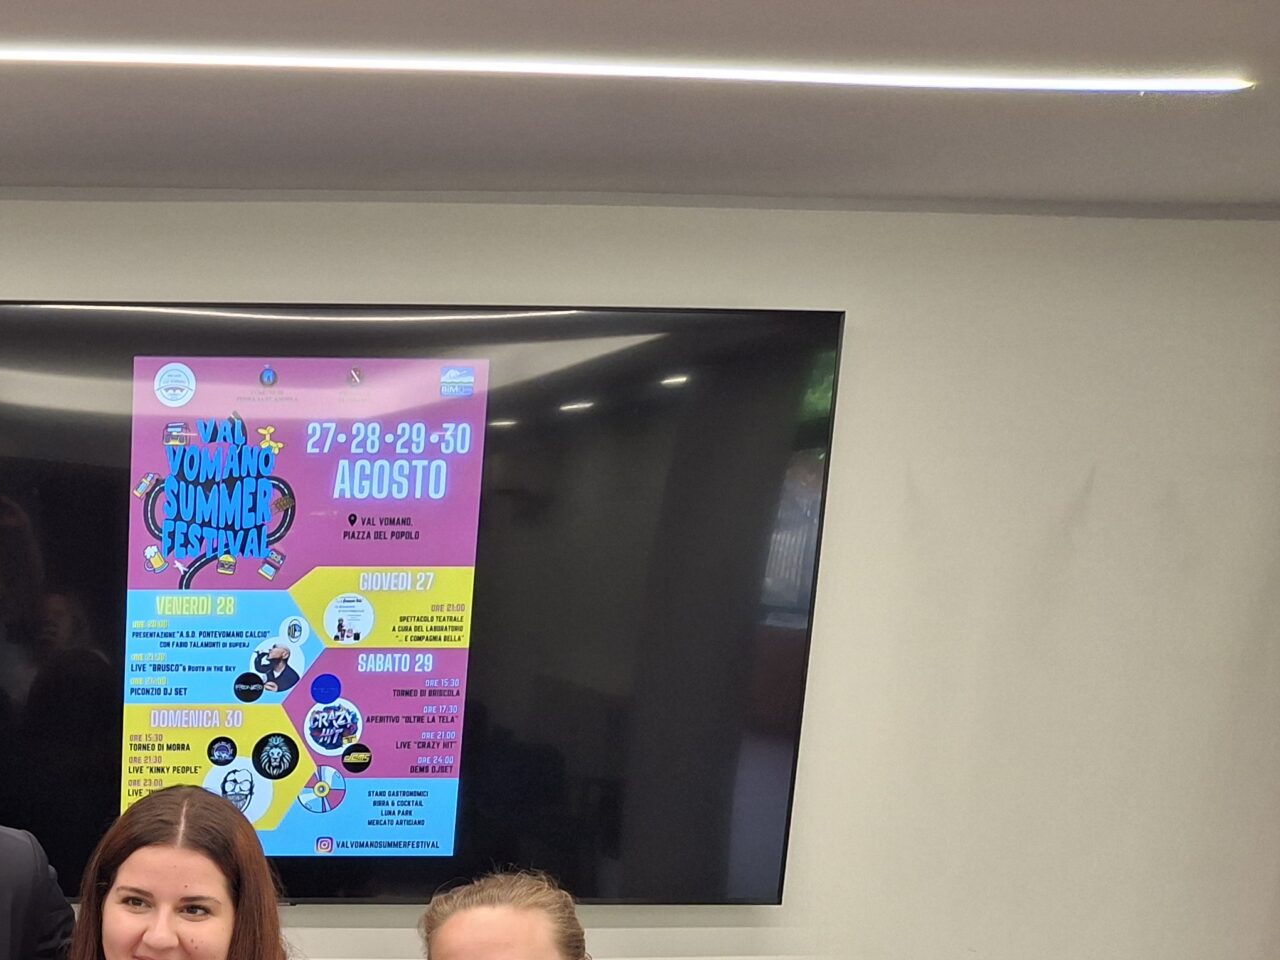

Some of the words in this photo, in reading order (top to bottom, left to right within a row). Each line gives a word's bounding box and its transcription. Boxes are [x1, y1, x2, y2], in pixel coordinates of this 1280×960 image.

[197, 418, 246, 446] VAL
[166, 446, 275, 482] VOMANO
[333, 460, 447, 500] AGOSTO
[163, 476, 273, 530] SUMMER
[361, 517, 377, 528] VAL
[161, 520, 272, 560] FESTIVAL
[343, 530, 371, 541] PIAZZA
[373, 530, 388, 541] DEL
[390, 530, 420, 541] POPOLO
[416, 573, 434, 591] 27
[217, 596, 235, 615] 28
[130, 664, 146, 672] LIVE
[358, 653, 410, 672] SABATO
[415, 653, 433, 672] 29
[130, 687, 161, 696] PICONZIO
[163, 687, 173, 696] DJ
[174, 687, 187, 696] SET
[150, 710, 220, 728] DOMENICA
[225, 710, 243, 728] 30
[129, 743, 155, 752] TORNEO
[158, 743, 165, 752] DI
[167, 743, 191, 752] MORRA
[396, 741, 411, 750] LIVE
[128, 766, 143, 774] LIVE
[128, 789, 143, 797] LIVE
[336, 840, 439, 849] VALVOMANOSUMMERFESTIVAL
